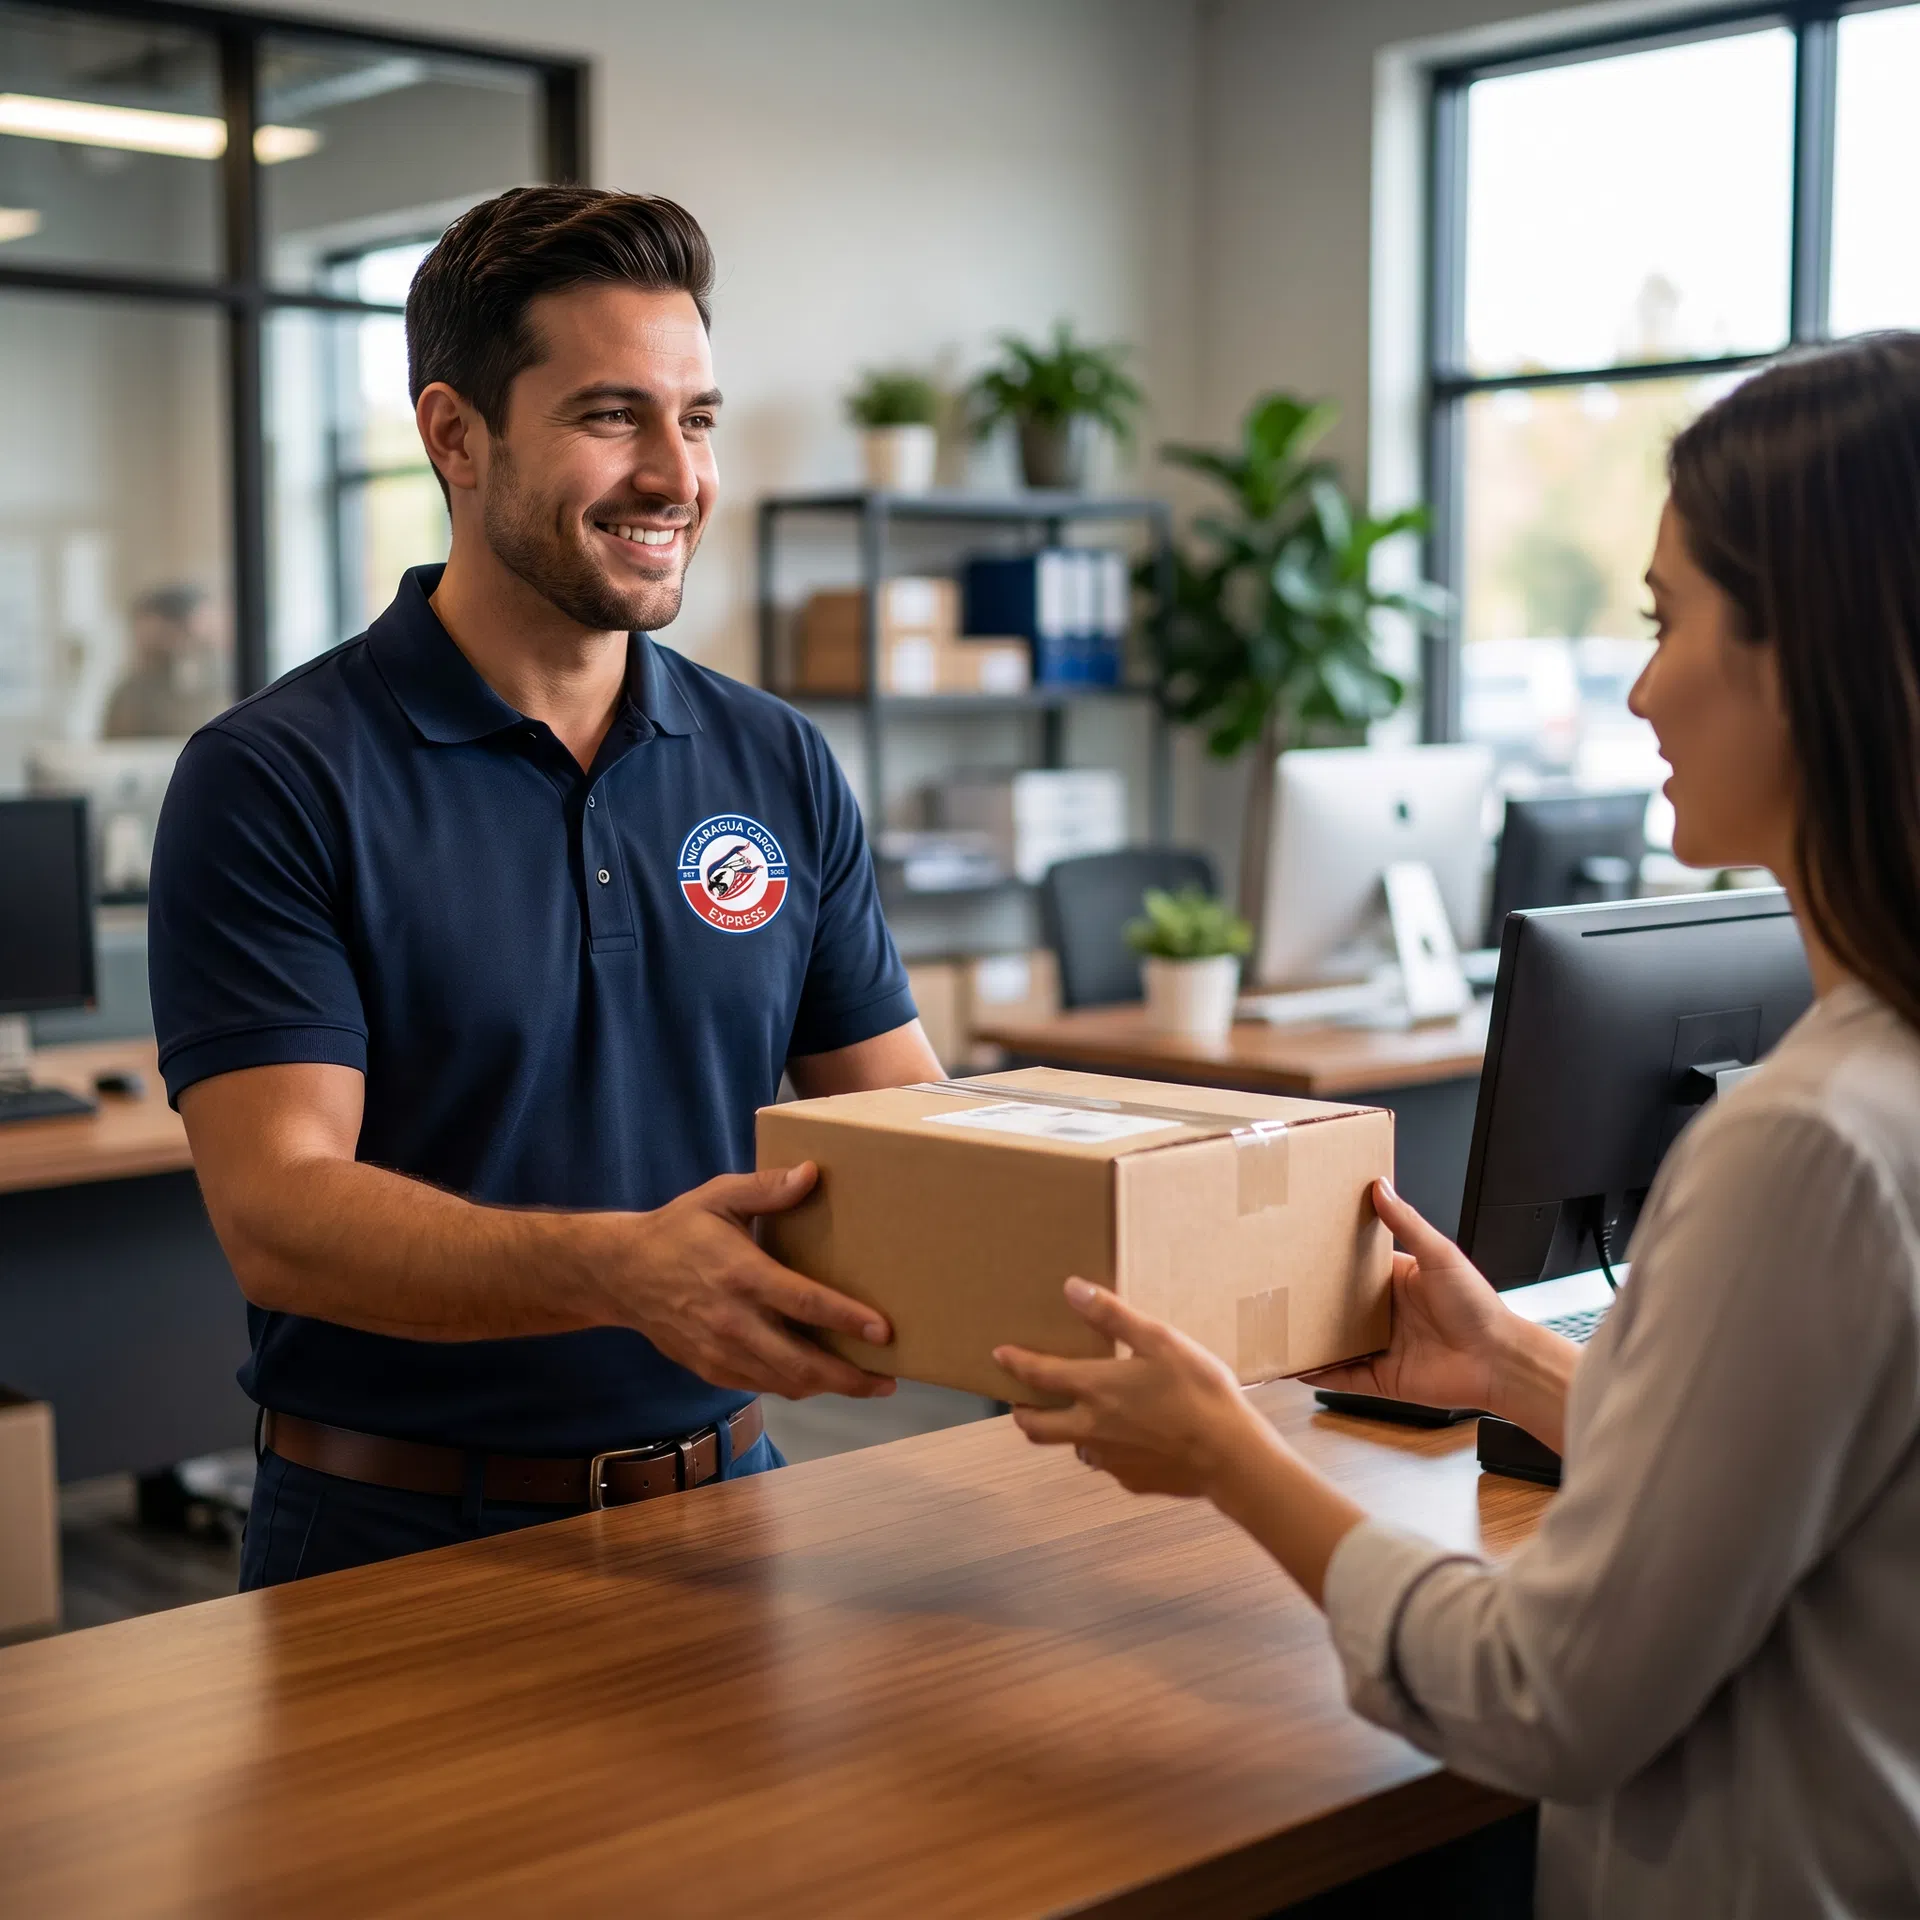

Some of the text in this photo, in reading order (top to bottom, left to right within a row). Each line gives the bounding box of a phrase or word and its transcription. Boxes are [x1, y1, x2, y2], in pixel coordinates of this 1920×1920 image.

[687, 821, 777, 863] NICARAGUA CARGO
[708, 907, 767, 926] EXPRESS
